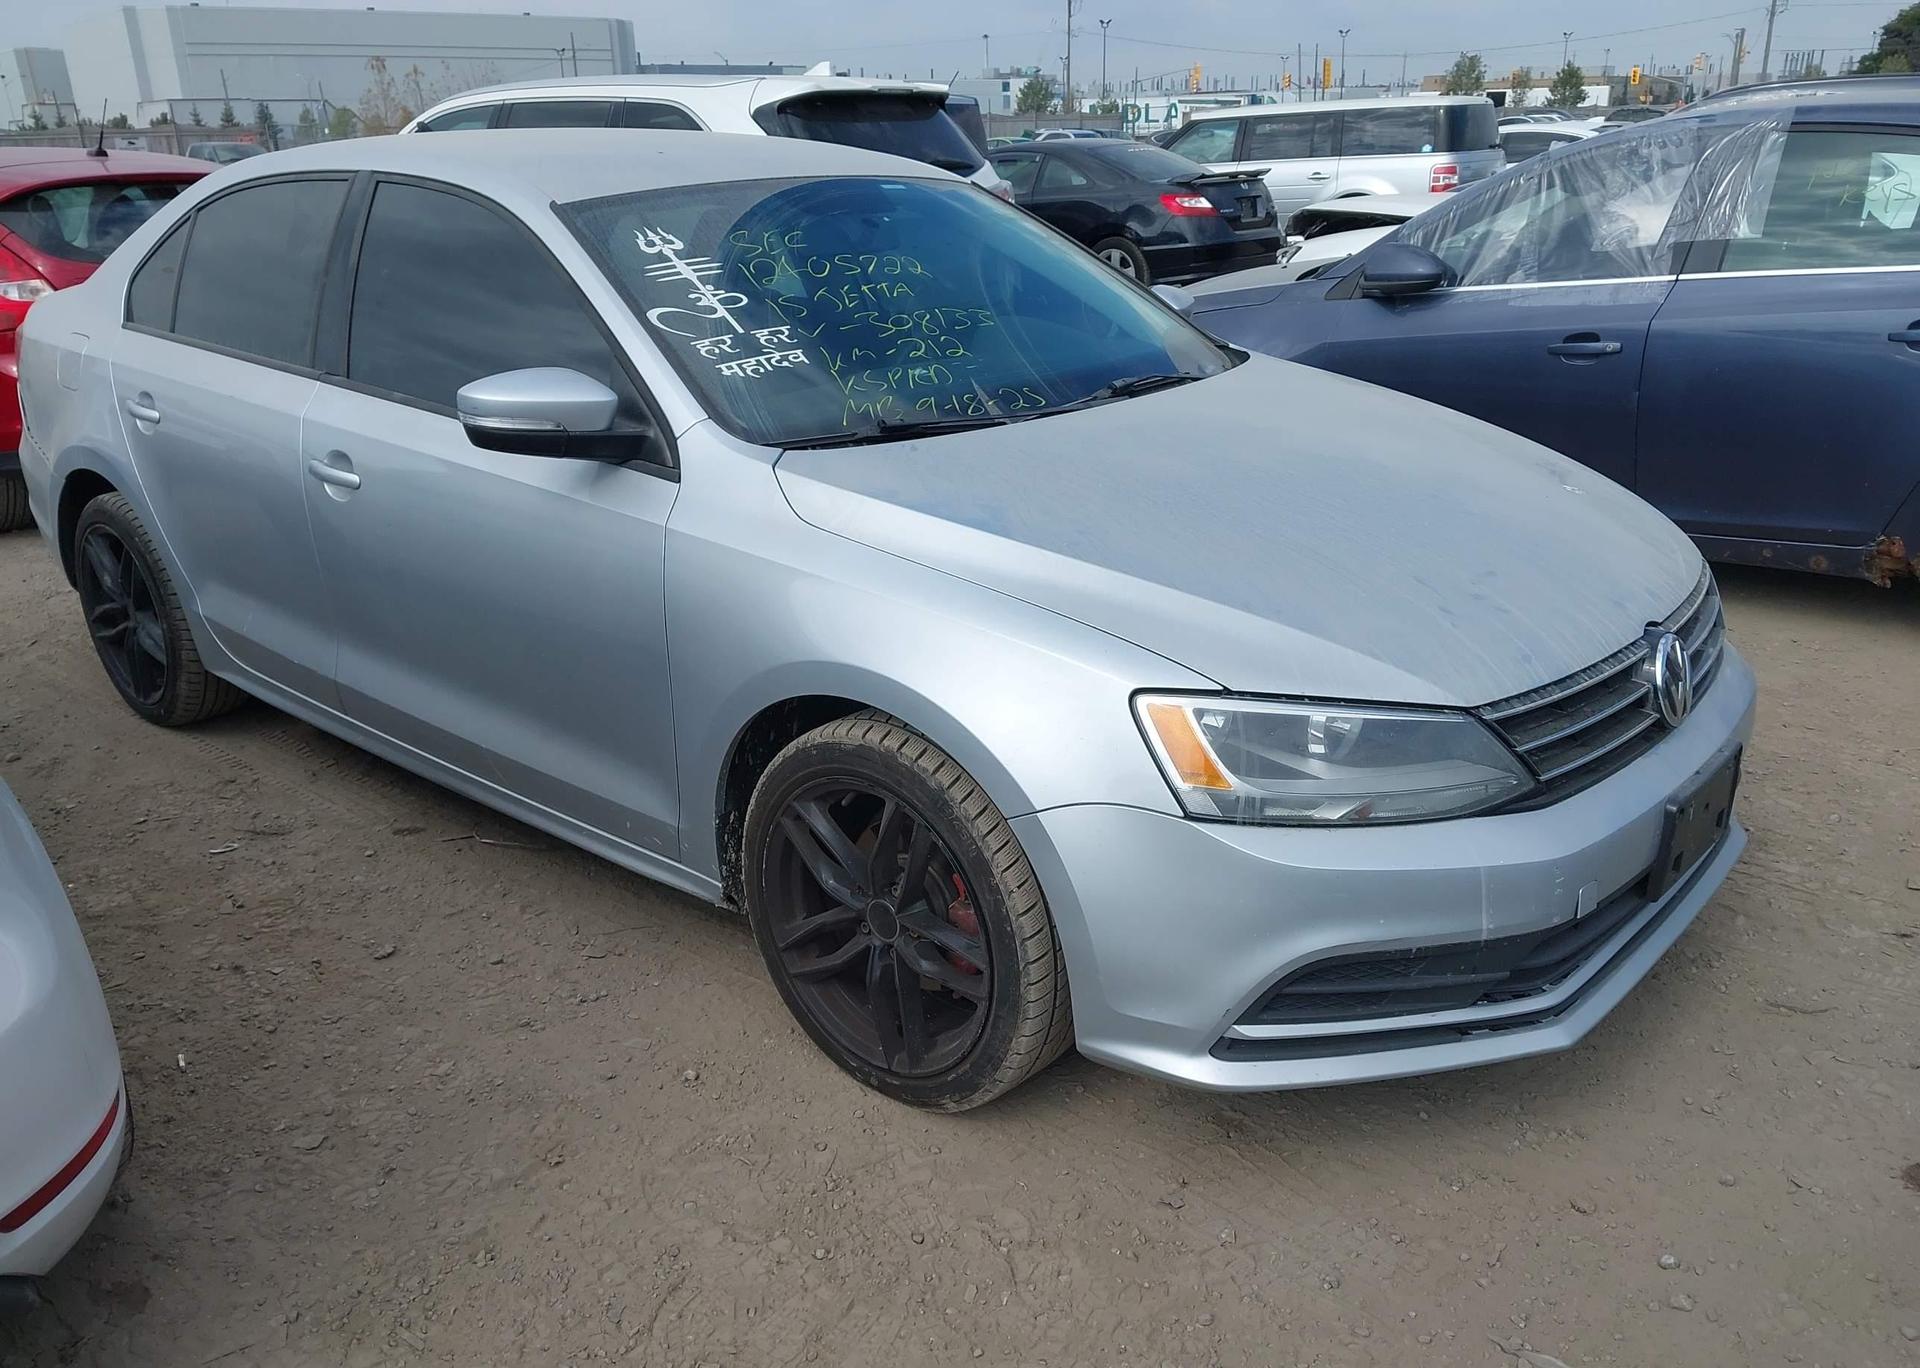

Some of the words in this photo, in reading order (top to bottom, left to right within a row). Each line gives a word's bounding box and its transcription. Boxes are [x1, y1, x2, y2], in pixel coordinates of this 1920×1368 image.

[814, 282, 916, 313] JETTA
[690, 334, 741, 360] हर
[750, 325, 799, 348] हर
[715, 348, 811, 379] महादेव
